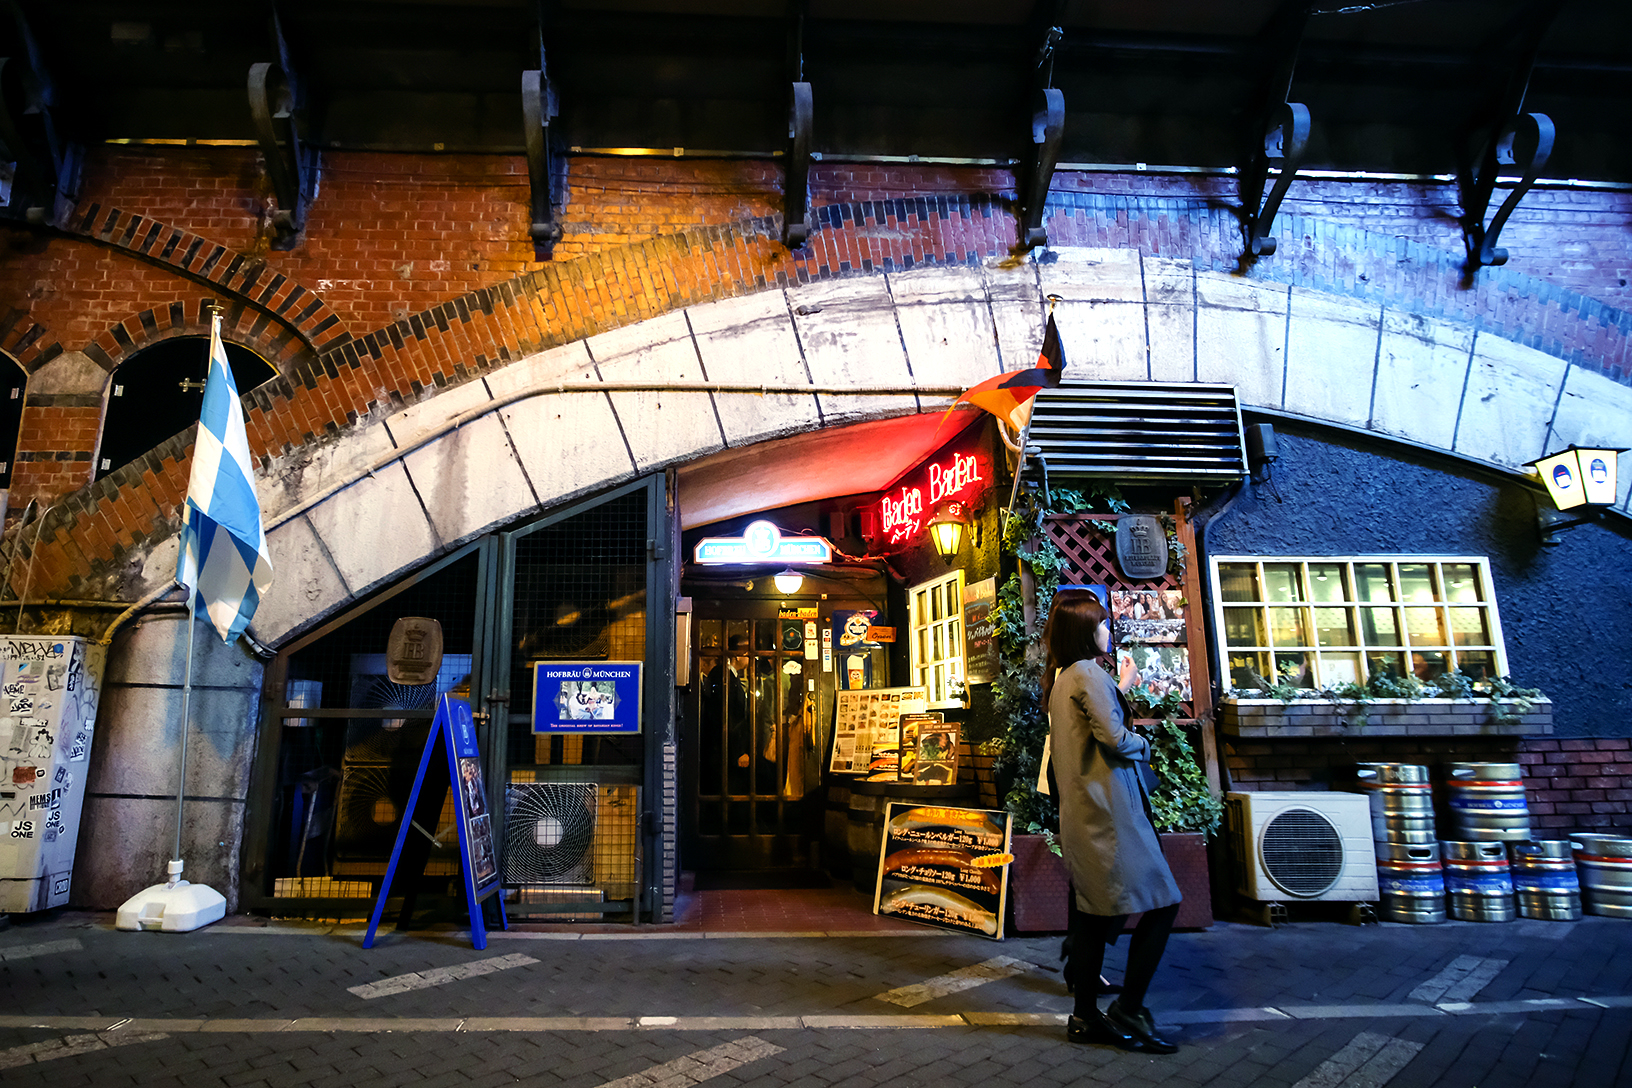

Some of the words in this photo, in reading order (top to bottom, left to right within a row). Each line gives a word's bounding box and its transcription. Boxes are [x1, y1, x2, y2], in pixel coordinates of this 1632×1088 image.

[882, 487, 923, 533] Baden
[928, 453, 983, 505] Baden
[546, 670, 582, 678] HOFBRÄU
[592, 670, 631, 678] MÜNCHEN
[49, 811, 60, 820] JS
[14, 821, 33, 831] JS
